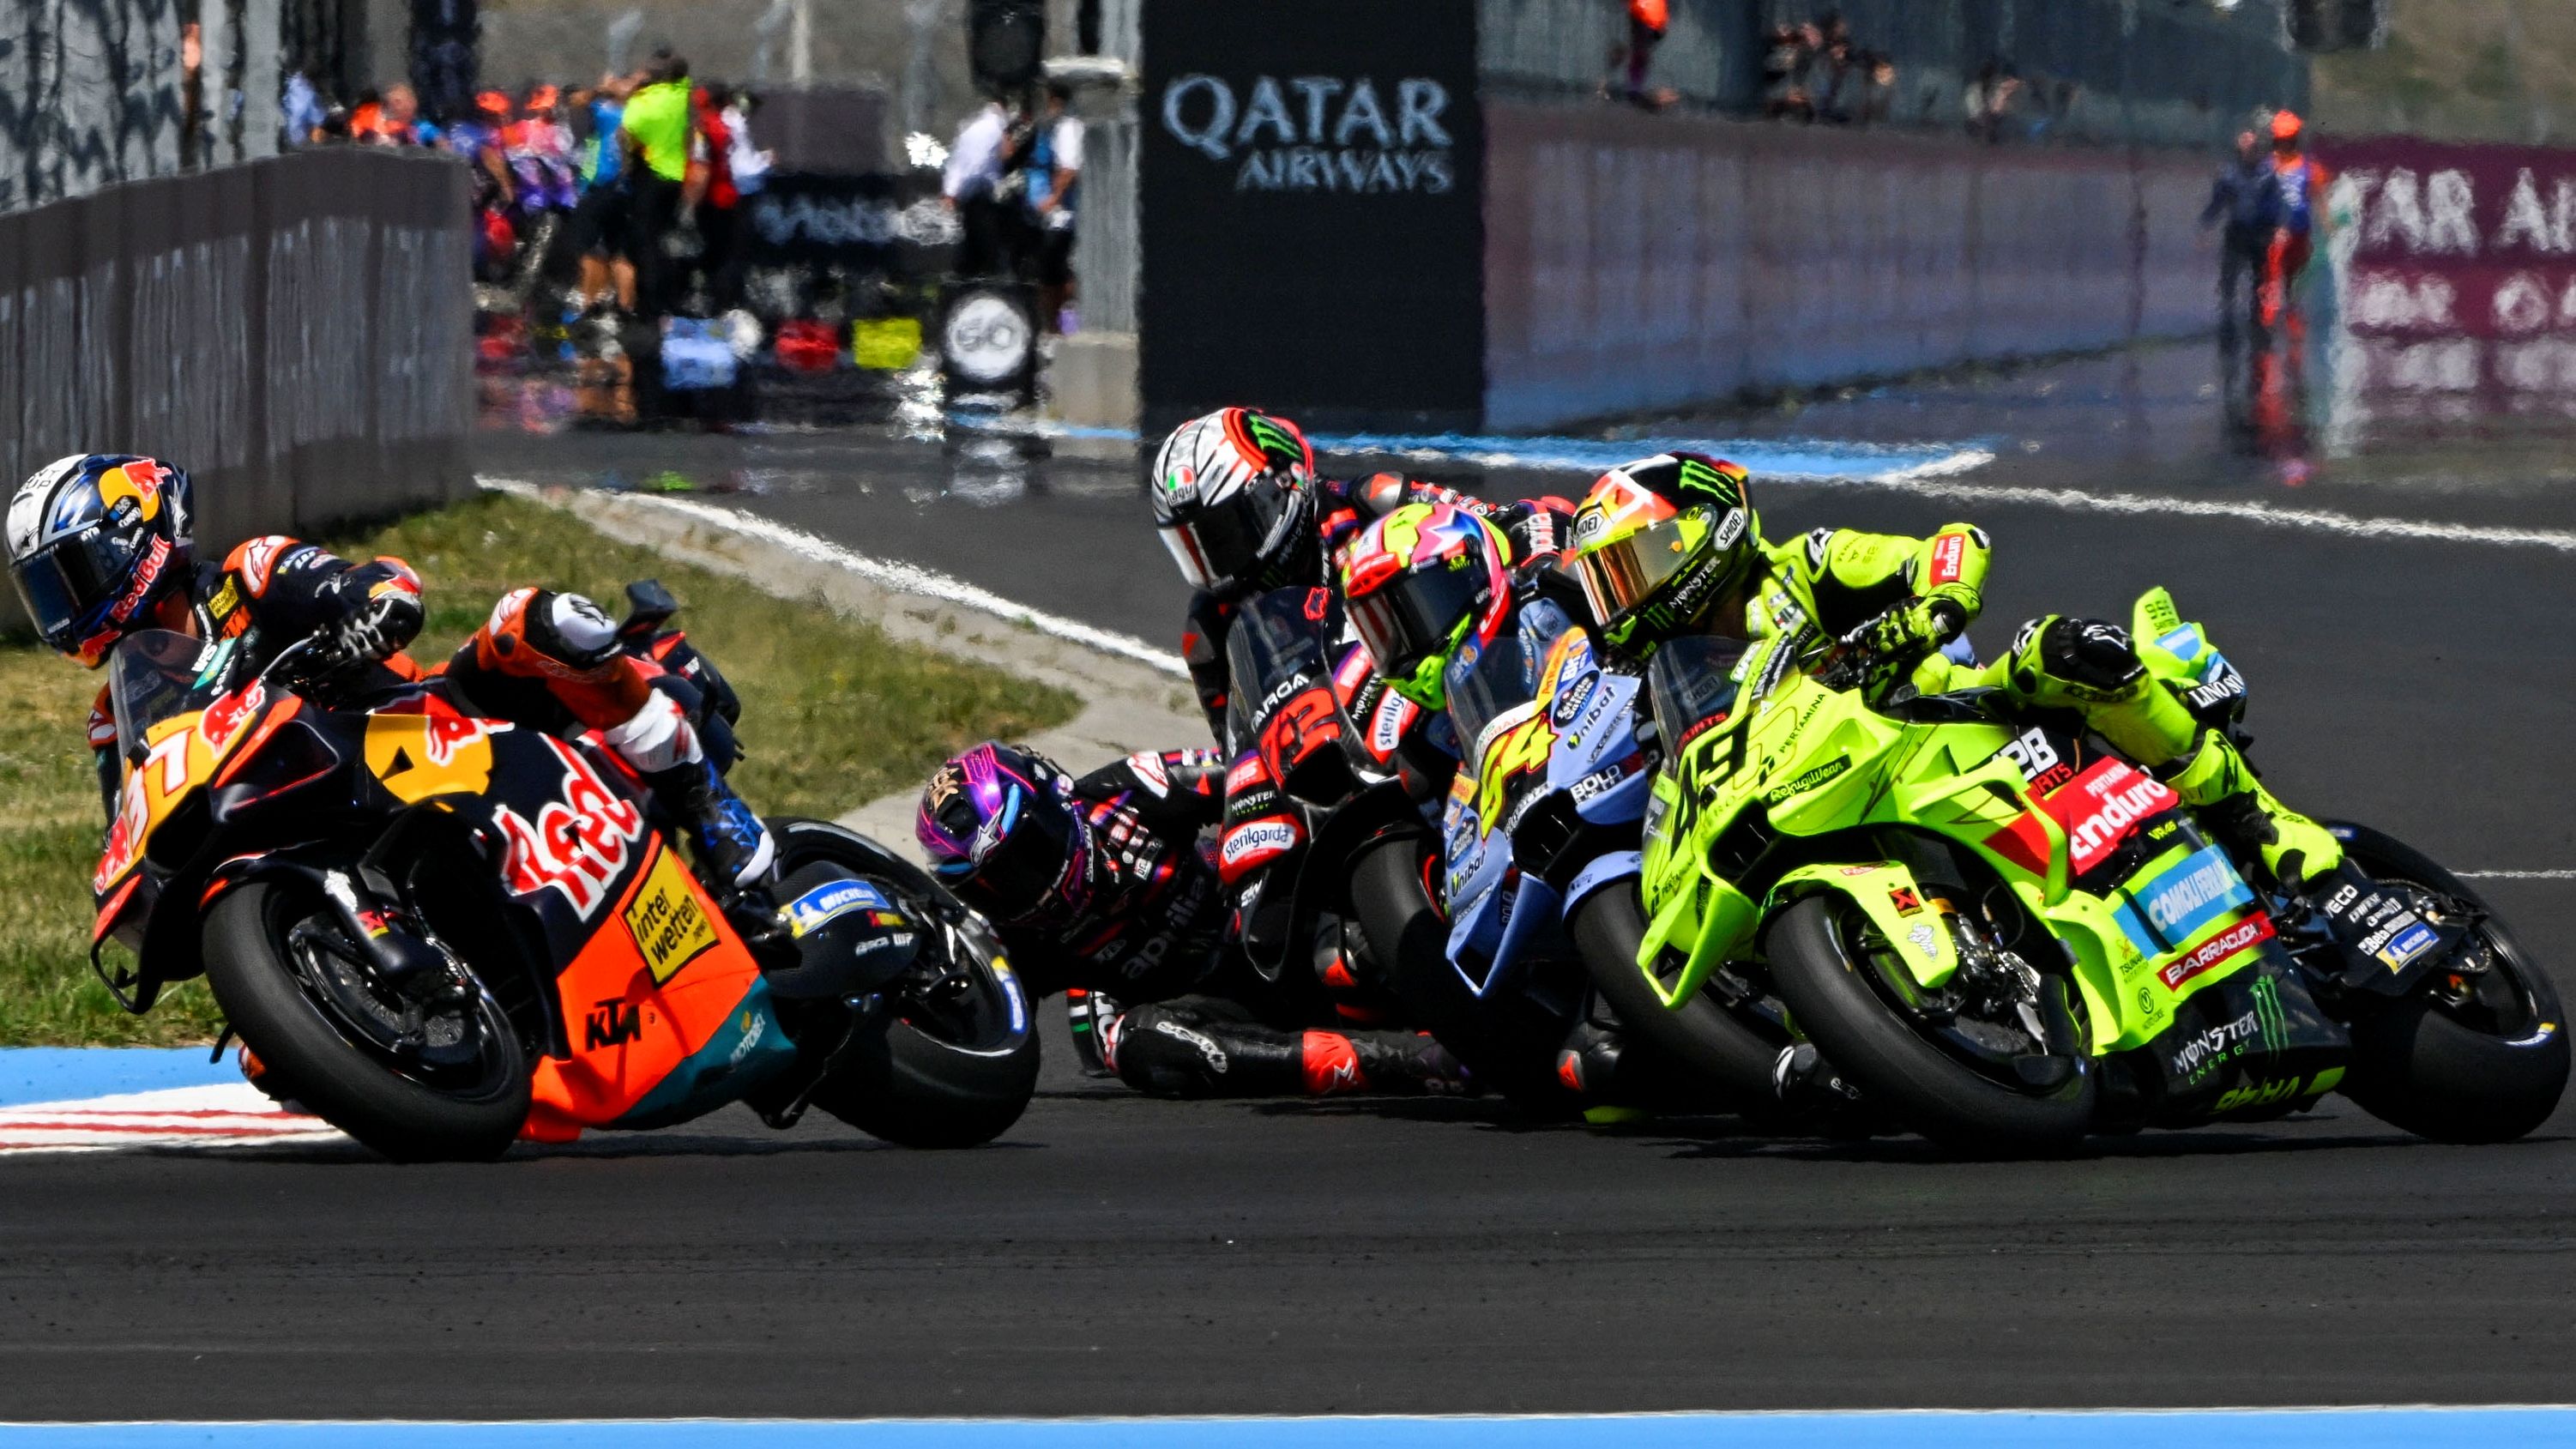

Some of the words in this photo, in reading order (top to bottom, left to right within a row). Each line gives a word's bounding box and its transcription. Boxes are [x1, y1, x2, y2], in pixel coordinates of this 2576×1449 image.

[1163, 74, 1452, 160] QATAR
[1236, 148, 1454, 194] AIRWAYS
[1718, 512, 1744, 546] SHOEI
[1941, 535, 1963, 577] Enduro
[2187, 681, 2231, 709] LINO
[1779, 692, 1827, 754] PERTAMINA
[1231, 789, 1276, 812] MONSTER
[1569, 764, 1621, 802] BOLD
[2084, 762, 2133, 798] PERTAMINA
[1225, 824, 1290, 859] sterilgarda
[2070, 777, 2169, 860] Enduro
[1451, 849, 1487, 897] Unibat
[629, 887, 673, 943] inter
[650, 894, 698, 966] wetten
[2165, 924, 2259, 985] BARRACUDA
[585, 997, 642, 1052] KTM
[2173, 1011, 2259, 1074] MONSTER
[2189, 1038, 2251, 1085] ENERGY
